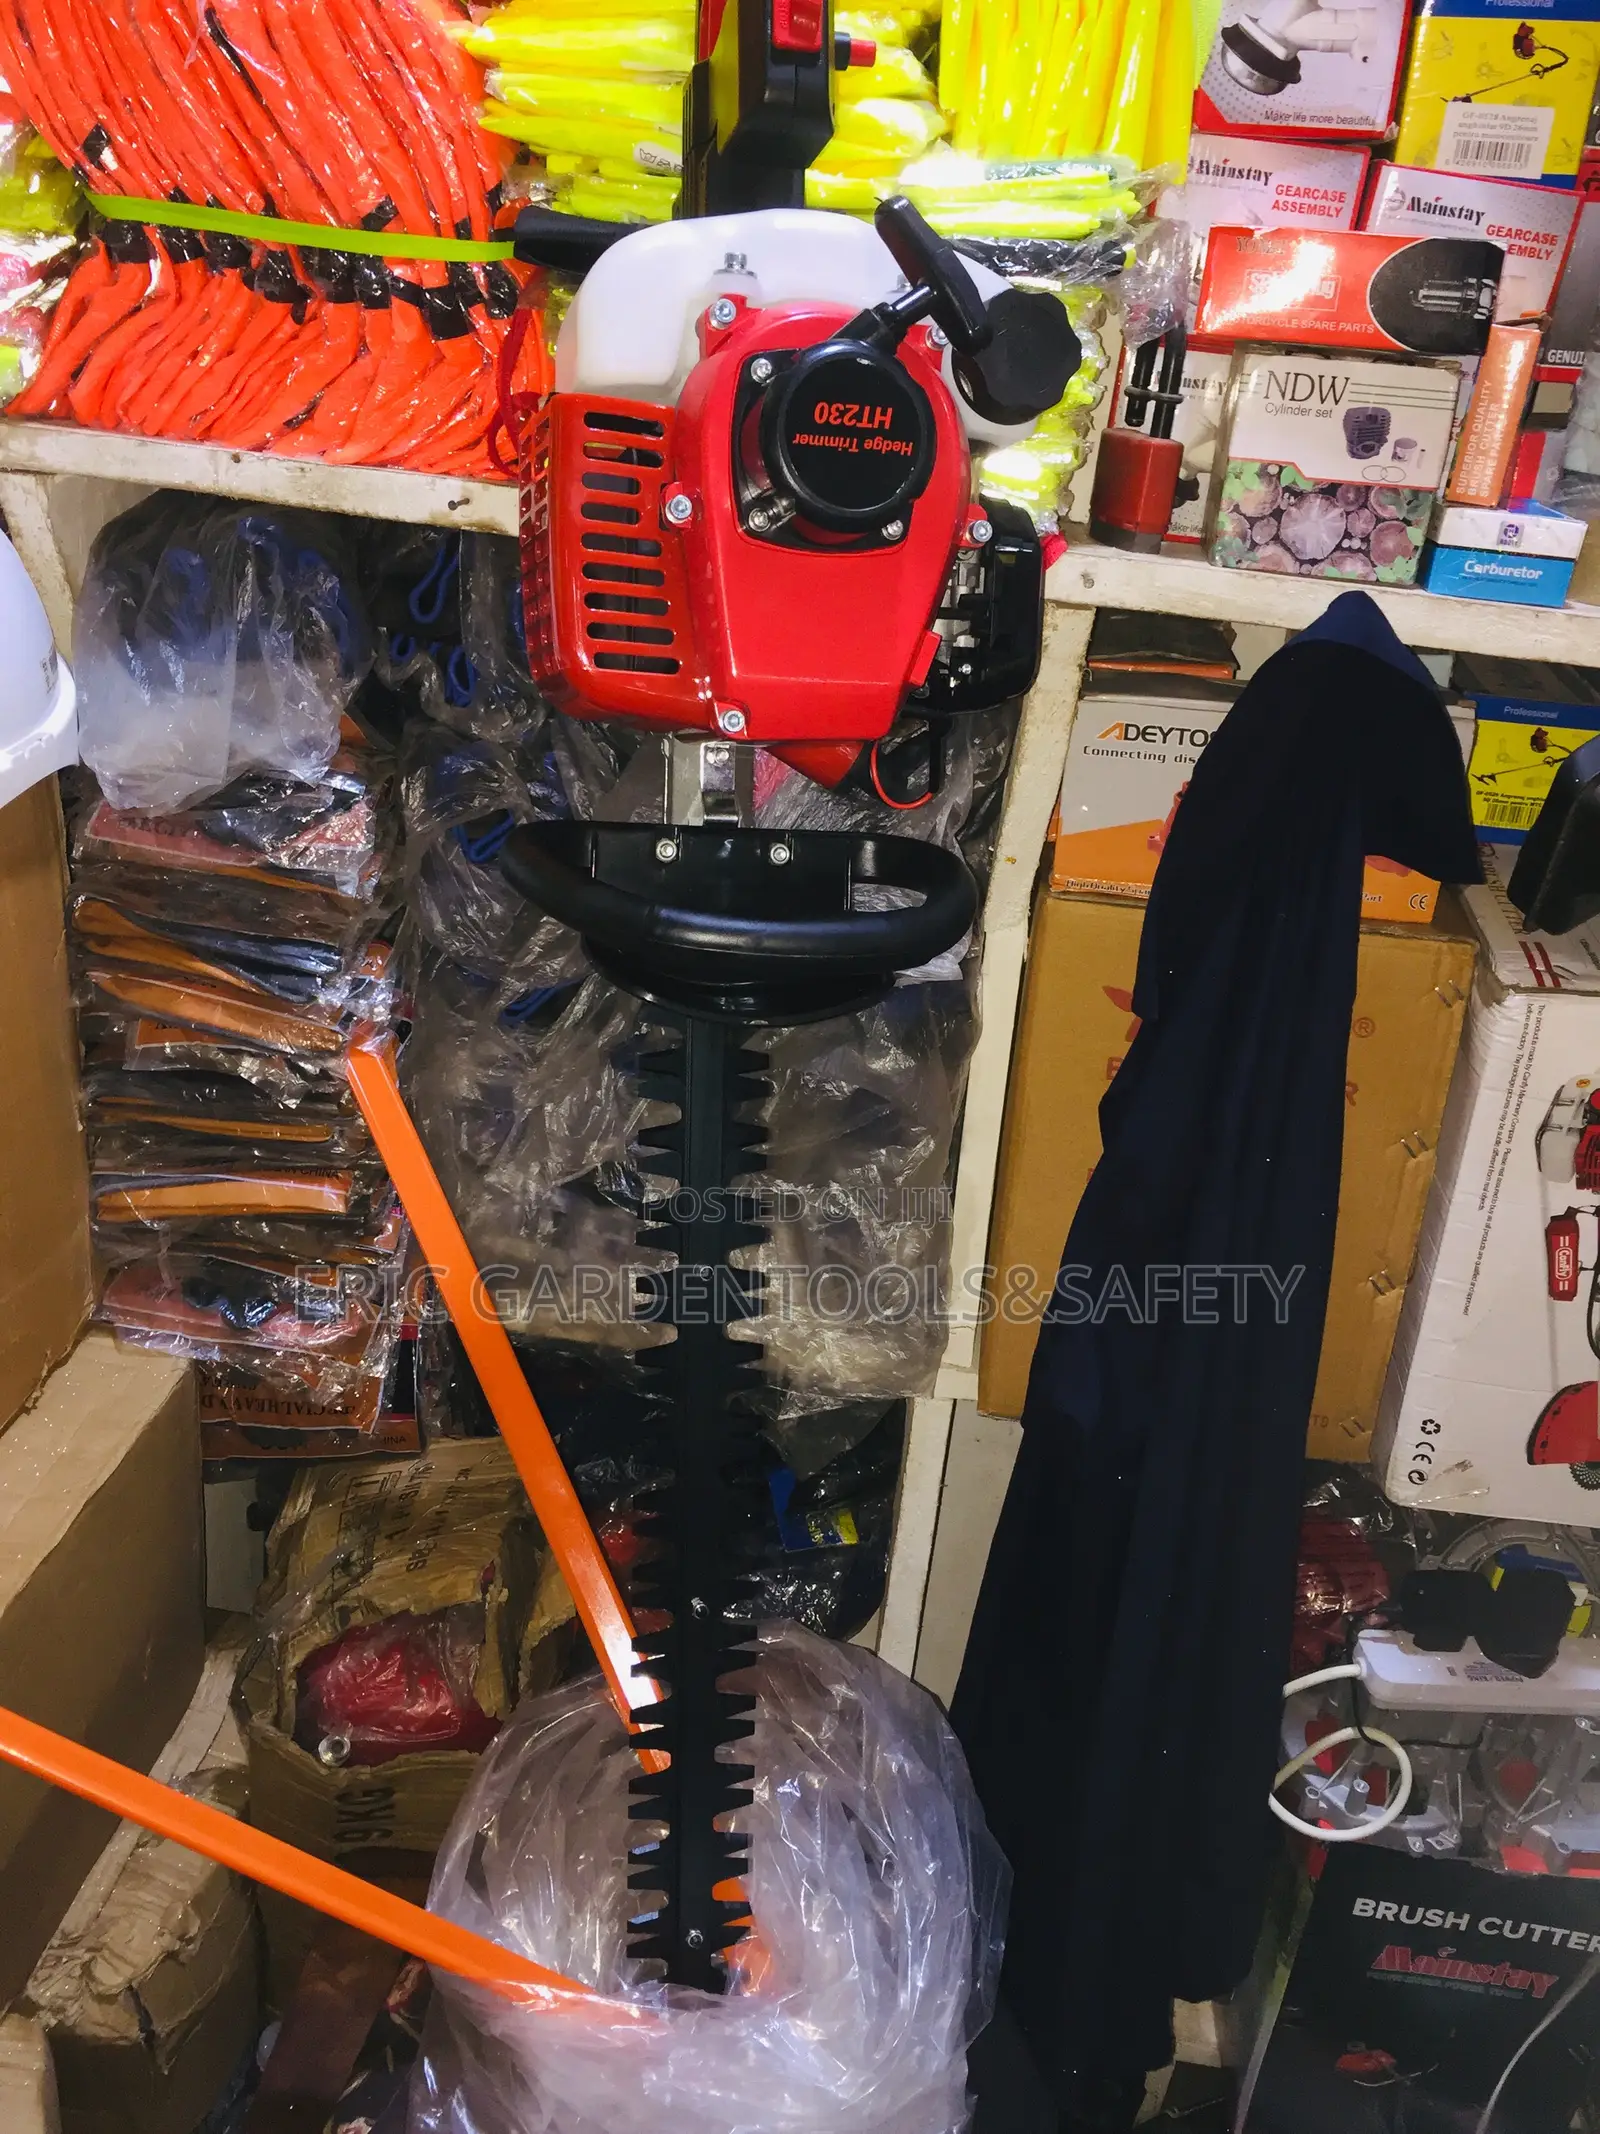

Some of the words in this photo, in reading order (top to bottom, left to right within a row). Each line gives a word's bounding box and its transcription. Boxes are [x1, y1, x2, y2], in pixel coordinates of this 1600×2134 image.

[1309, 114, 1333, 124] more
[1196, 159, 1273, 187] Mainstay
[1275, 184, 1348, 204] GEARCASE
[1272, 200, 1344, 219] ASSEMBLY
[1406, 196, 1486, 226] Mainstay
[1486, 224, 1559, 247] GEARCASE
[1507, 243, 1554, 261] EMBLY
[1227, 312, 1299, 329] TORCYCLE
[1301, 319, 1337, 331] SPARE
[1338, 322, 1375, 334] PARTS
[1547, 349, 1587, 365] GENUI
[1264, 370, 1351, 406] NDW
[814, 401, 893, 429] HT230
[1265, 402, 1312, 418] Cylinder
[1315, 408, 1333, 419] set
[792, 433, 859, 452] Trimmer
[864, 436, 913, 456] Hedge
[1456, 433, 1479, 494] SUPERIOR
[1472, 380, 1492, 432] QUALITY
[1467, 455, 1486, 496] BRUSH
[1479, 403, 1500, 450] CUTTER
[1480, 458, 1497, 498] SPARE
[1464, 560, 1543, 580] Carburetor
[1504, 706, 1559, 719] Professional
[1097, 721, 1216, 748] ADEYTO
[1083, 745, 1166, 764] Connecting
[1174, 754, 1197, 765] dis
[1531, 1016, 1543, 1040] product
[1505, 1117, 1519, 1144] Company
[1352, 1897, 1470, 1931] BRUSH
[1371, 1944, 1559, 1999] Mainstay
